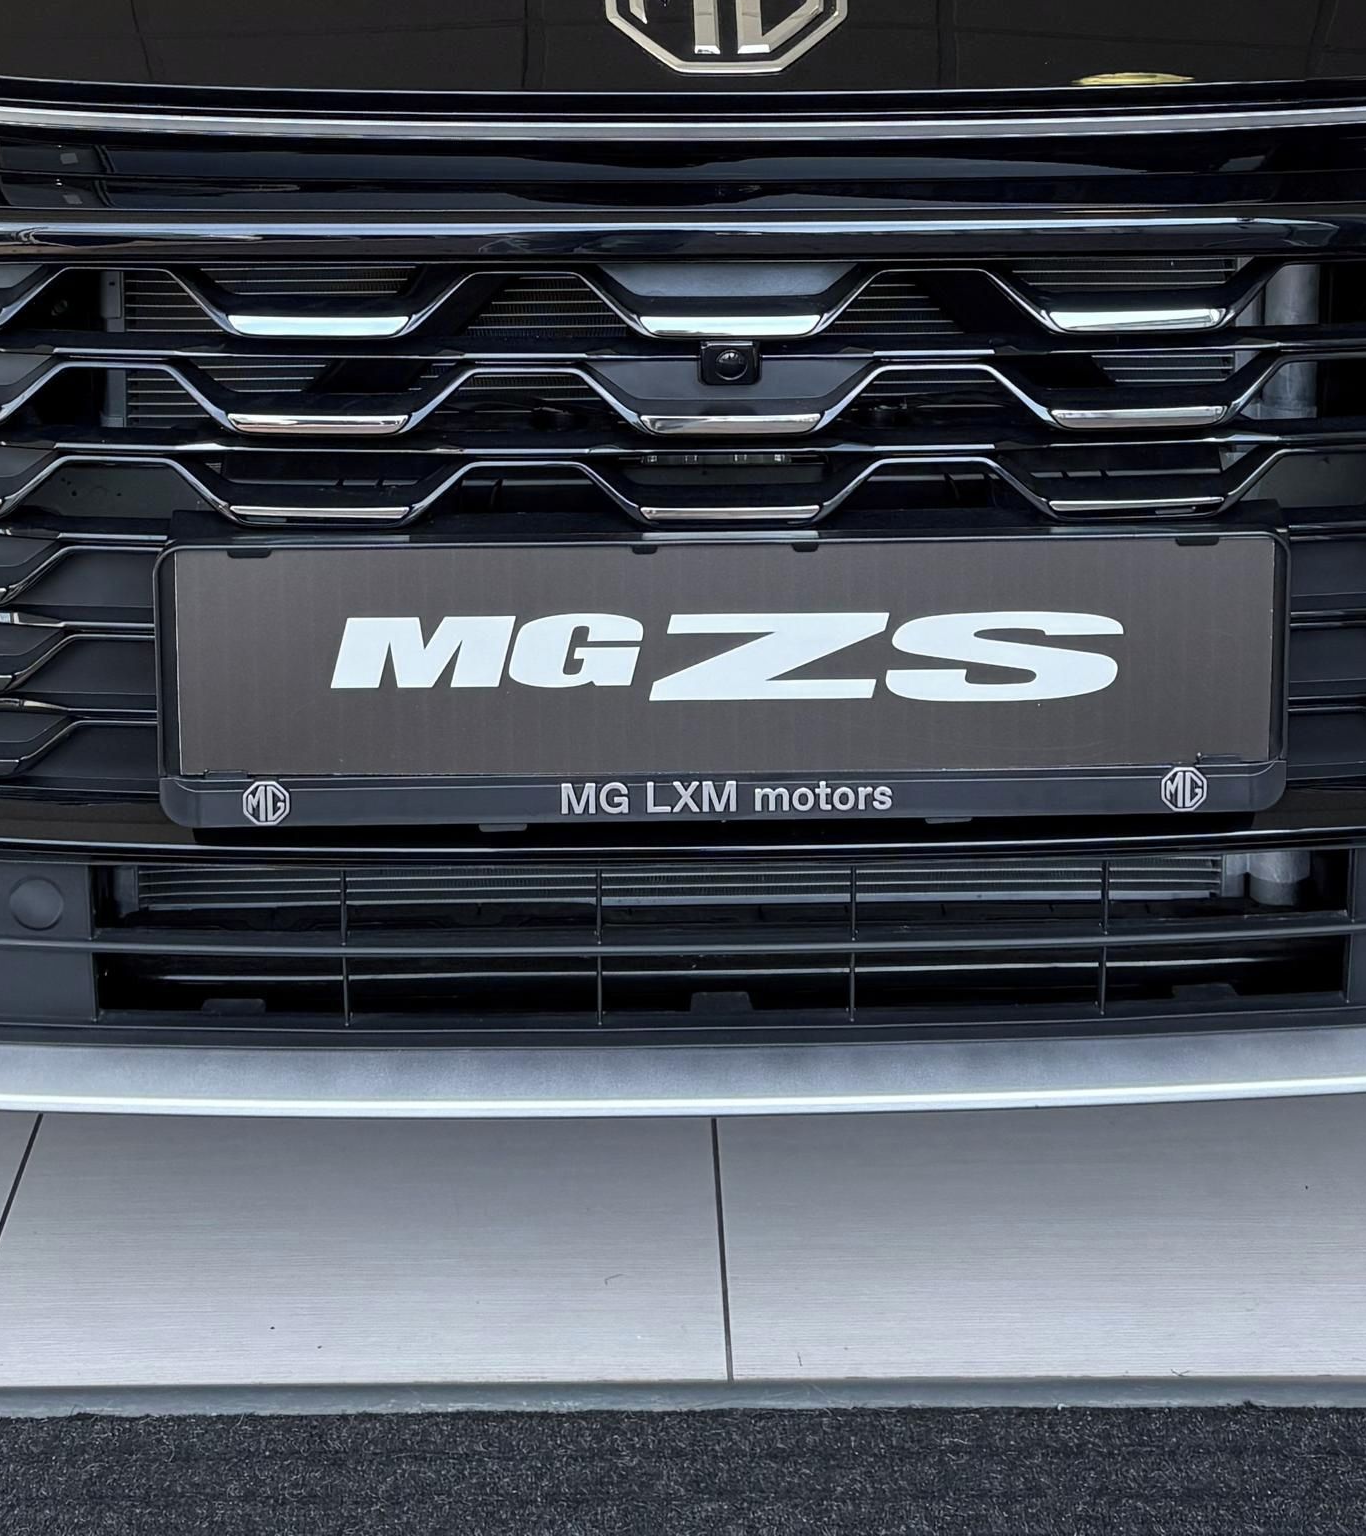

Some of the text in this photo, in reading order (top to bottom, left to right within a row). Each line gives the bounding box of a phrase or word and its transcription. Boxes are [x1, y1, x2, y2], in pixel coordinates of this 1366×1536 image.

[247, 785, 285, 822] MG
[560, 780, 893, 815] MG LXM motors
[1165, 771, 1202, 808] MG
